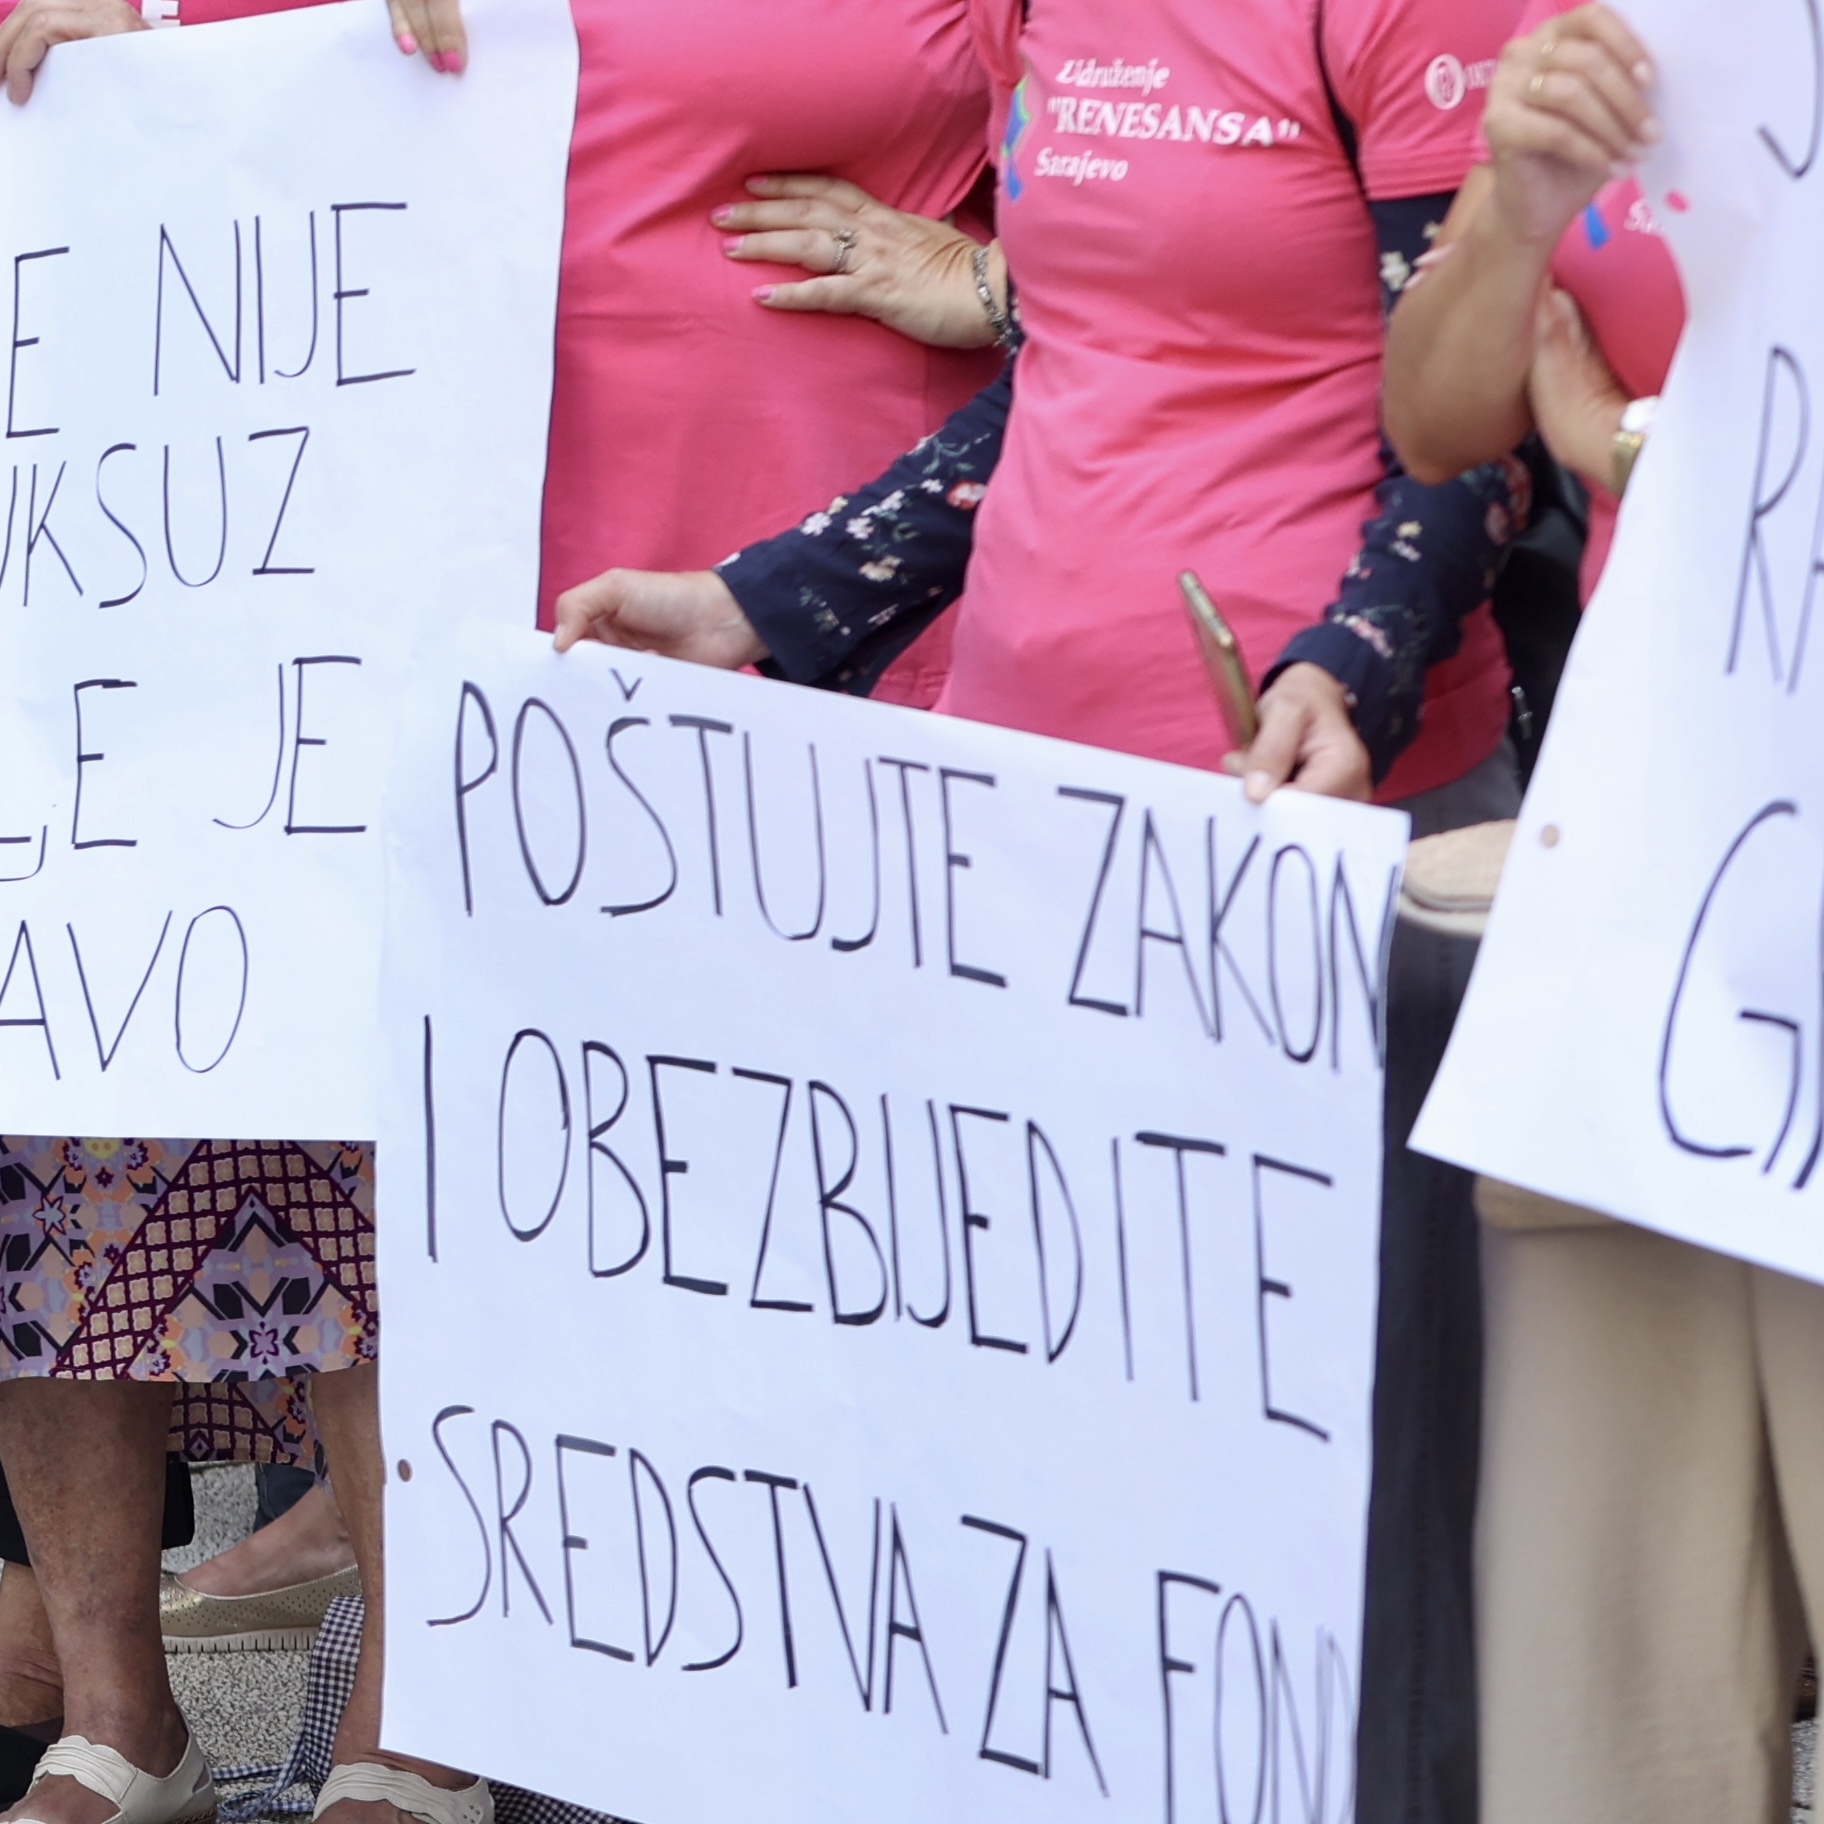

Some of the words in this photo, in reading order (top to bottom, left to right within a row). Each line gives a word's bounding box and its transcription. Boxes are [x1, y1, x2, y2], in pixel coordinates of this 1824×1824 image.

[1034, 146, 1129, 187] Sarajevo
[1055, 57, 1171, 97] Udruženje
[153, 201, 416, 397] NIJE
[211, 655, 367, 836] JE
[454, 668, 1009, 988] POŠTUJTE
[1057, 786, 1400, 1073] ZAKON
[424, 1014, 440, 1264] I
[497, 1028, 1334, 1443] OBEZBIJEDITE
[426, 1404, 950, 1737] SREDSTVA
[961, 1514, 1110, 1799] ZA
